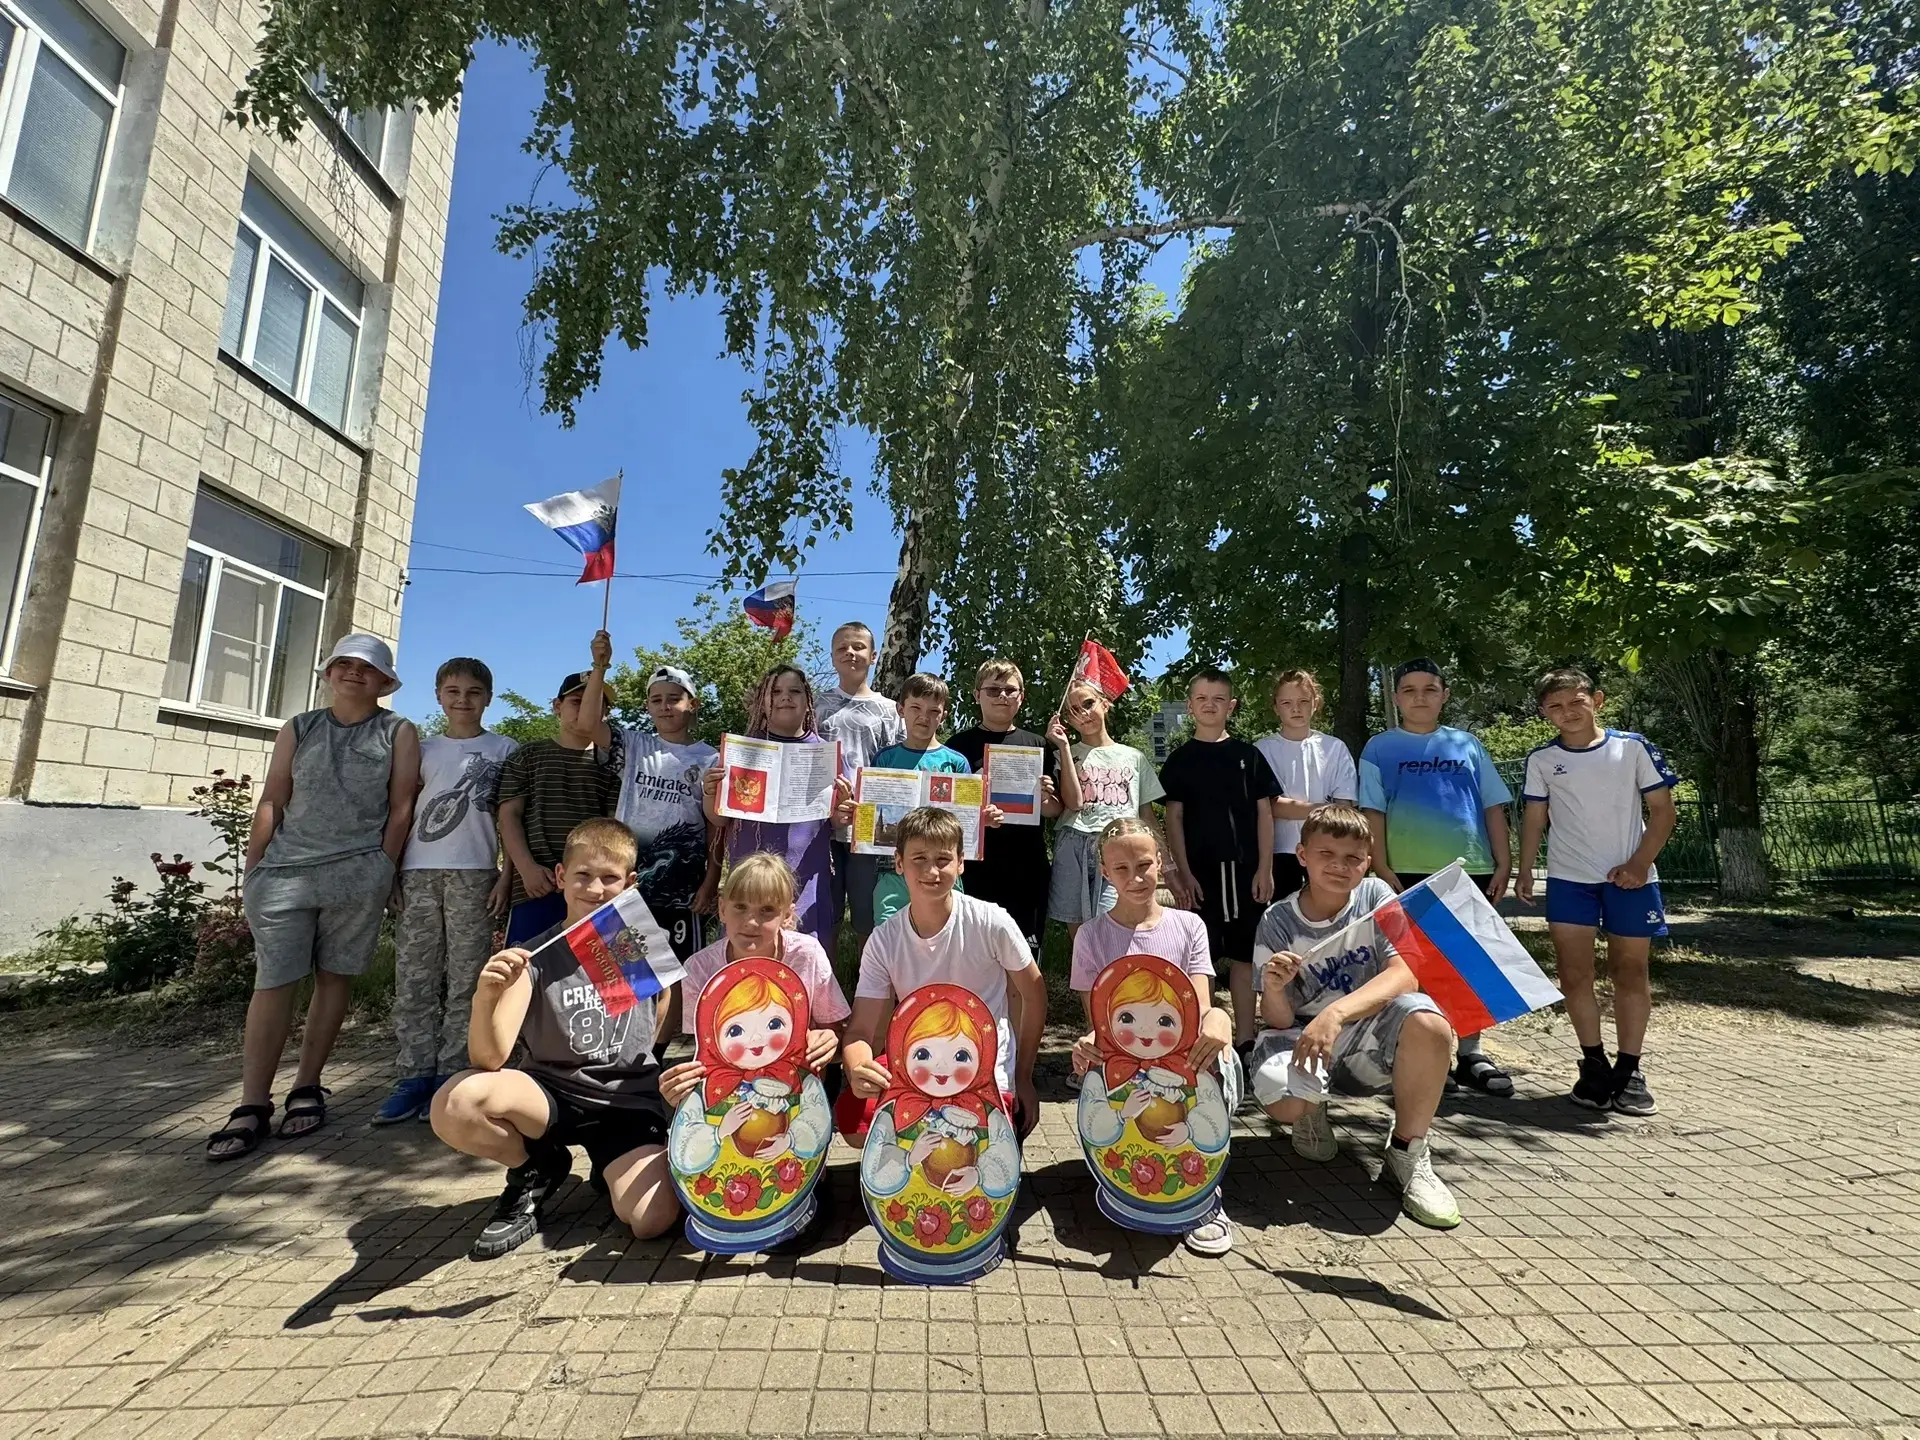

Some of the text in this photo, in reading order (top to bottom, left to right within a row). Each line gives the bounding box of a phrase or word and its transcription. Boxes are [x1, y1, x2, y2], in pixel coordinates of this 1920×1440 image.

[635, 771, 692, 797] Emirates
[652, 789, 682, 804] BETTER
[673, 919, 687, 945] 9
[586, 939, 619, 984] РОССИЯ
